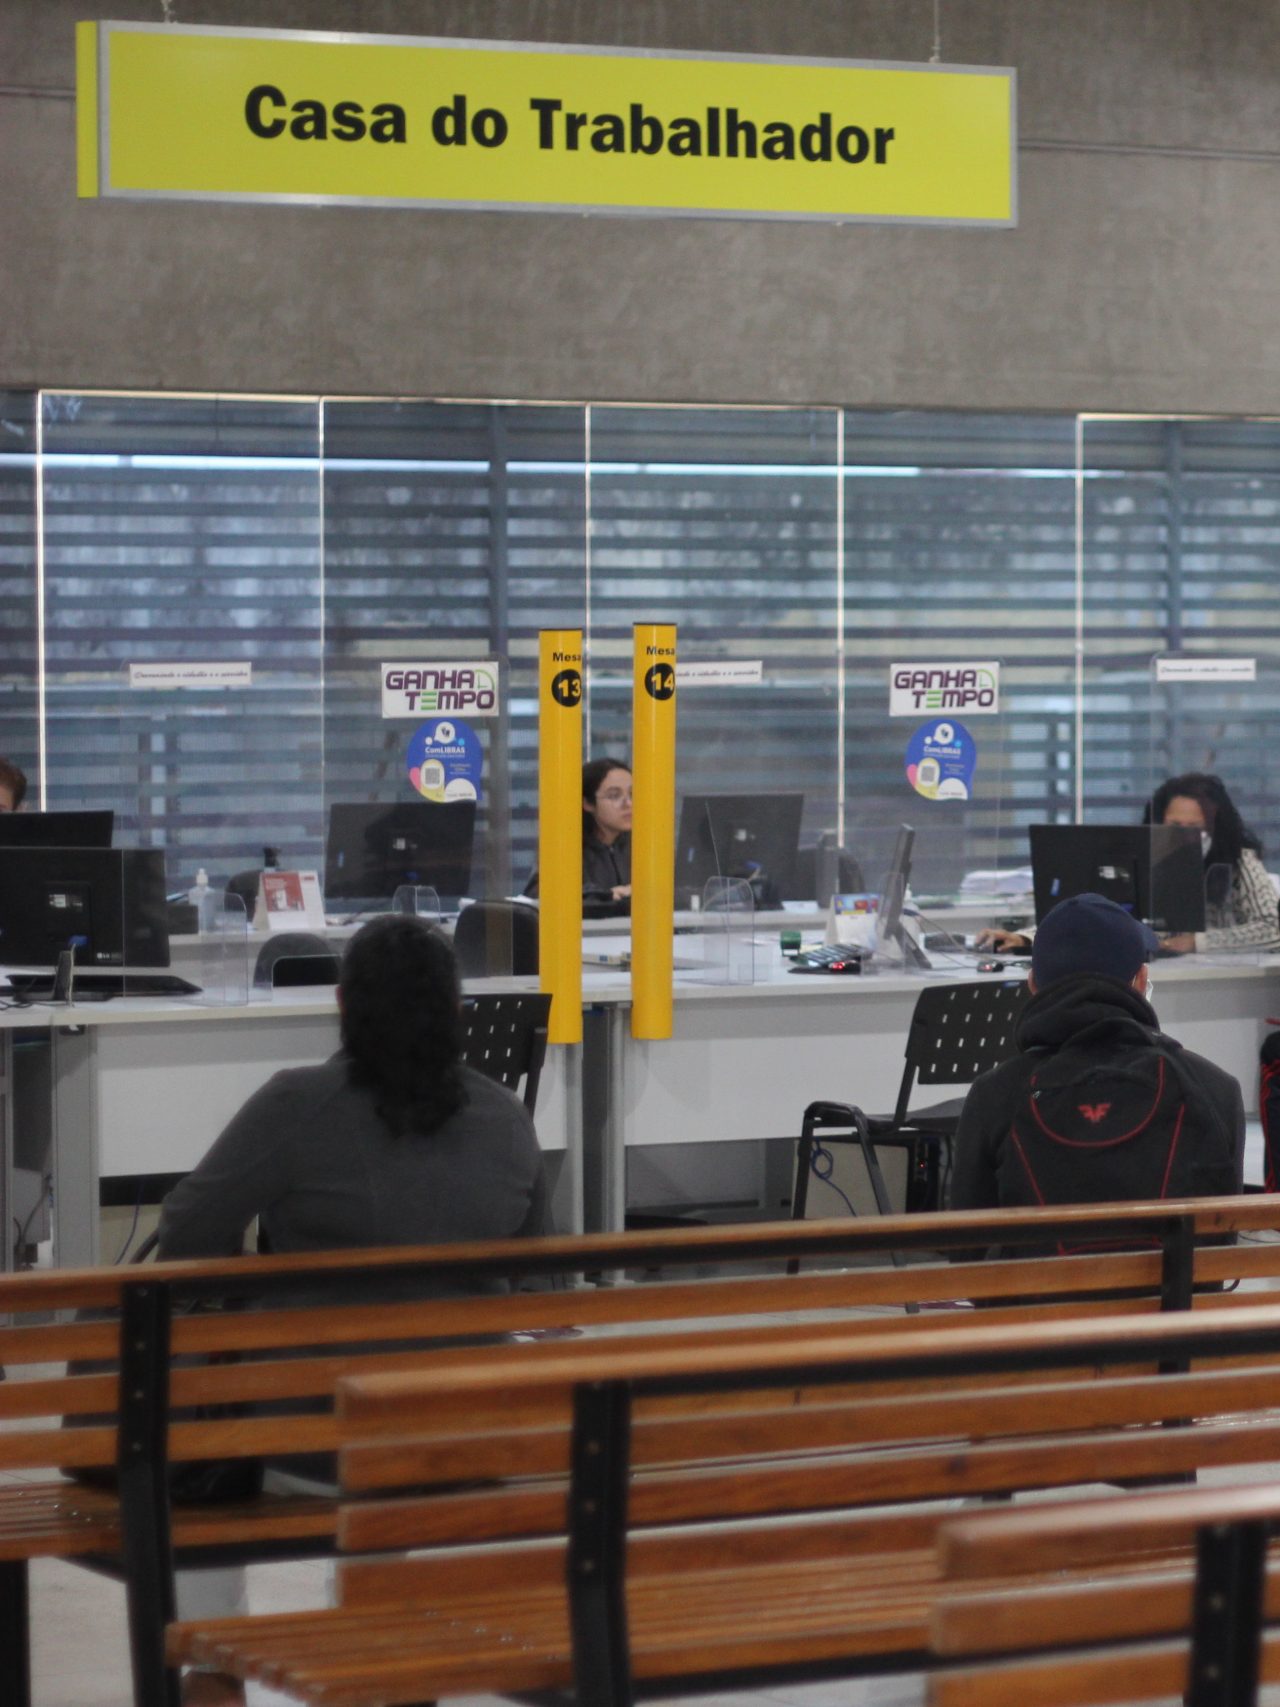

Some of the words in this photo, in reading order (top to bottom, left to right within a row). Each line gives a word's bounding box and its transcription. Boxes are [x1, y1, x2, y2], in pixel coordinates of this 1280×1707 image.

[245, 84, 407, 144] Casa
[431, 94, 509, 148] do
[530, 97, 894, 165] Trabalhador
[386, 669, 475, 690] GANHA
[558, 679, 581, 697] 13
[651, 672, 674, 691] 14
[894, 669, 977, 689] GANHA
[405, 690, 495, 710] TEMPO
[912, 689, 995, 709] TEMPO
